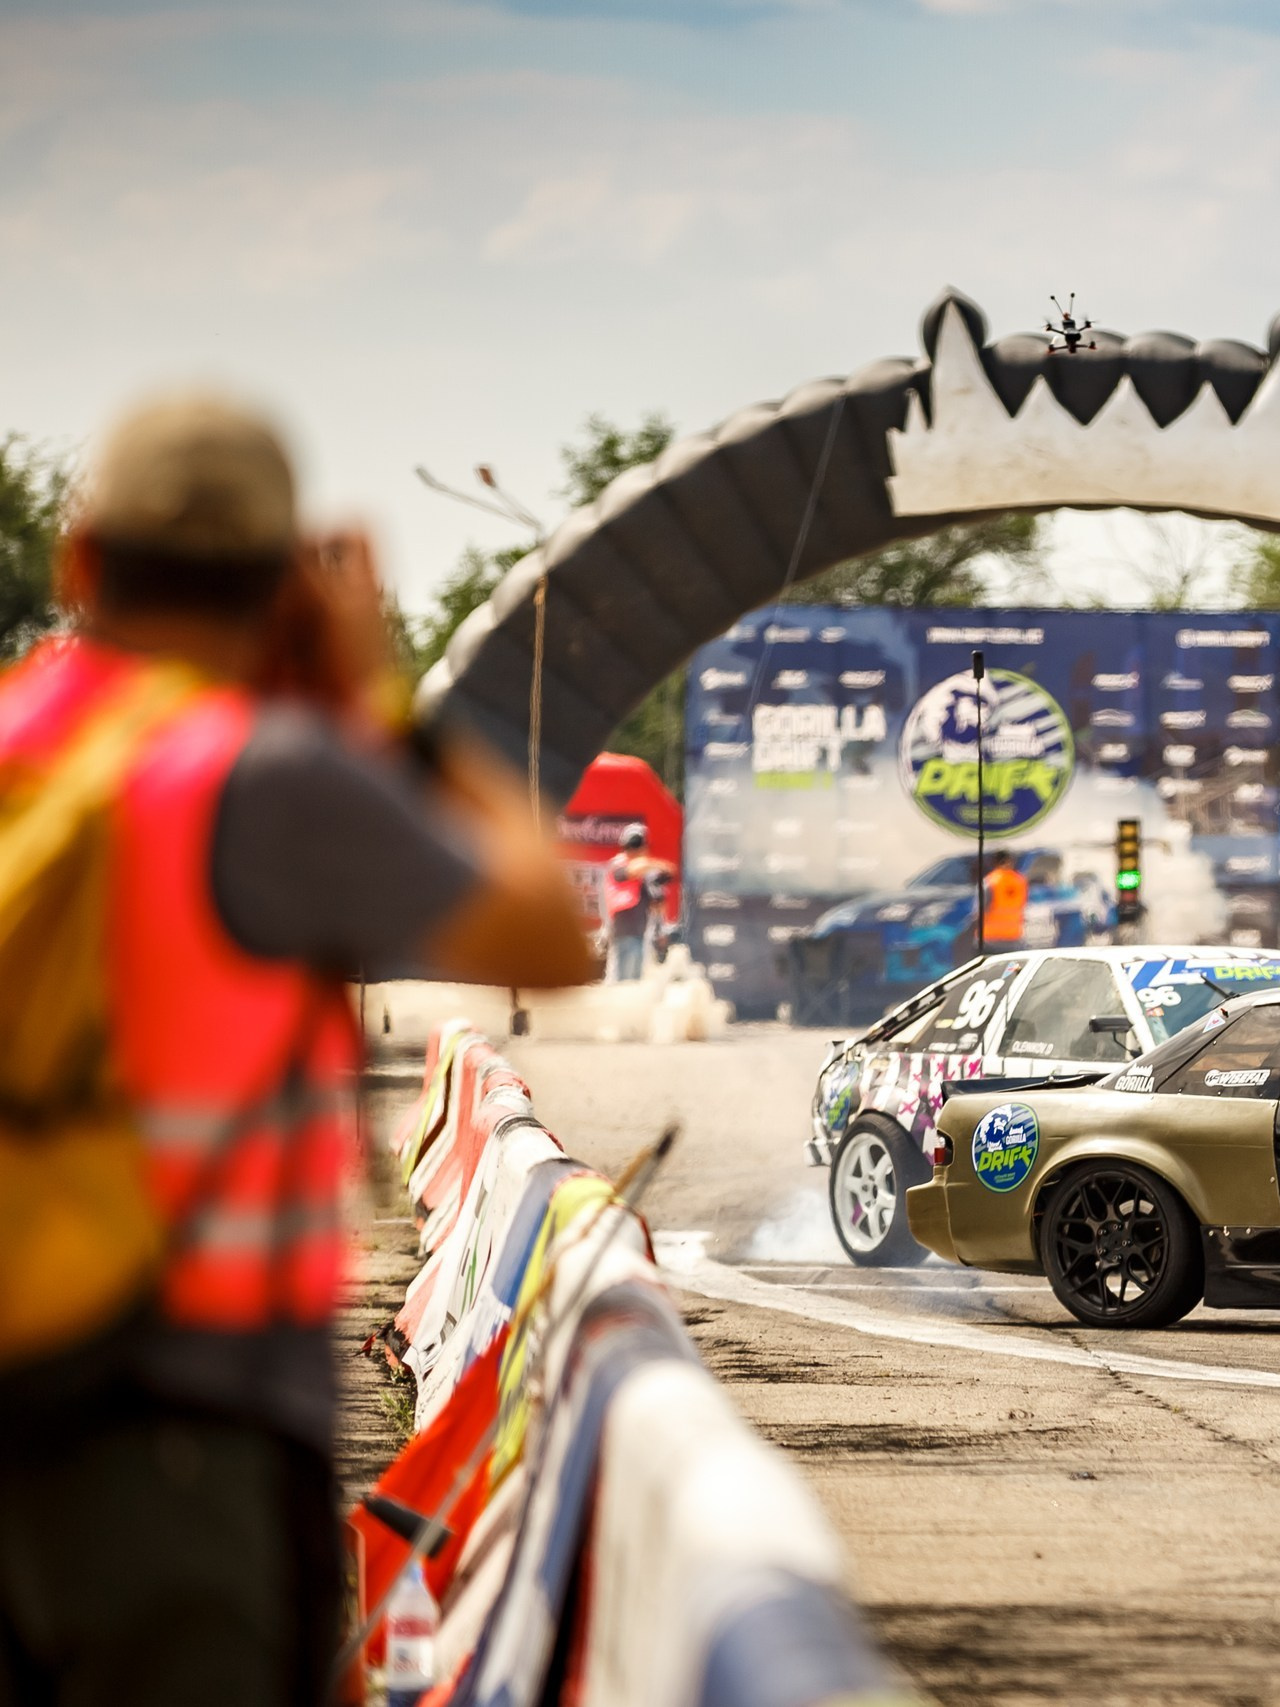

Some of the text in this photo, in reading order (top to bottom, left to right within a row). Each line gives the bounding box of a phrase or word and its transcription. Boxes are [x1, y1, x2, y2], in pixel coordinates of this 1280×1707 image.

[951, 979, 1006, 1031] 96
[1136, 985, 1182, 1008] 96
[1114, 1075, 1155, 1092] GORILLA
